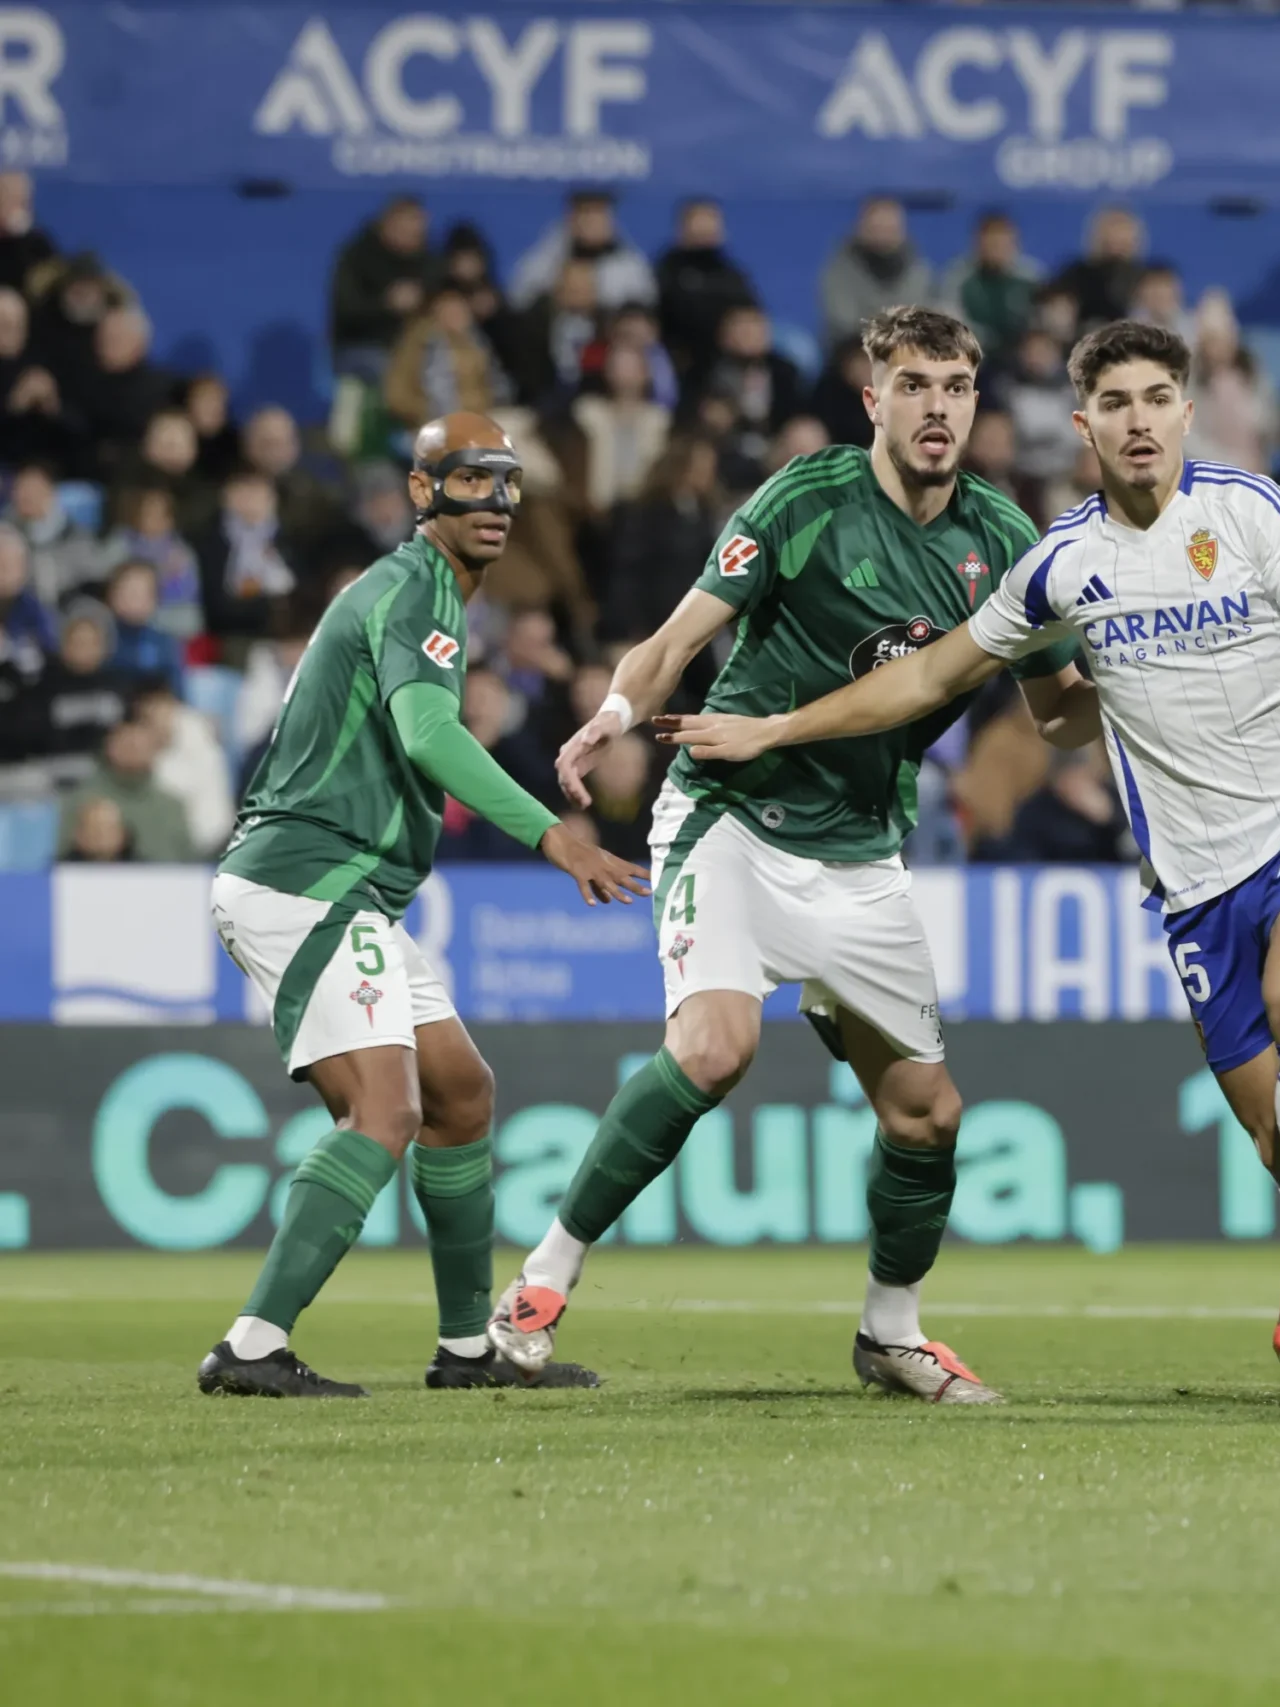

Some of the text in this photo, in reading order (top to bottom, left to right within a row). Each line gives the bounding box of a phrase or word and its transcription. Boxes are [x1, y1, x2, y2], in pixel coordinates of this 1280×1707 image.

[253, 16, 652, 137] ACYF
[815, 28, 1173, 140] ACYF
[1083, 590, 1250, 651] CARAVAN
[669, 874, 696, 924] 4
[350, 925, 386, 976] 5
[1175, 942, 1211, 1003] 5
[93, 1050, 1124, 1254] Caalua,
